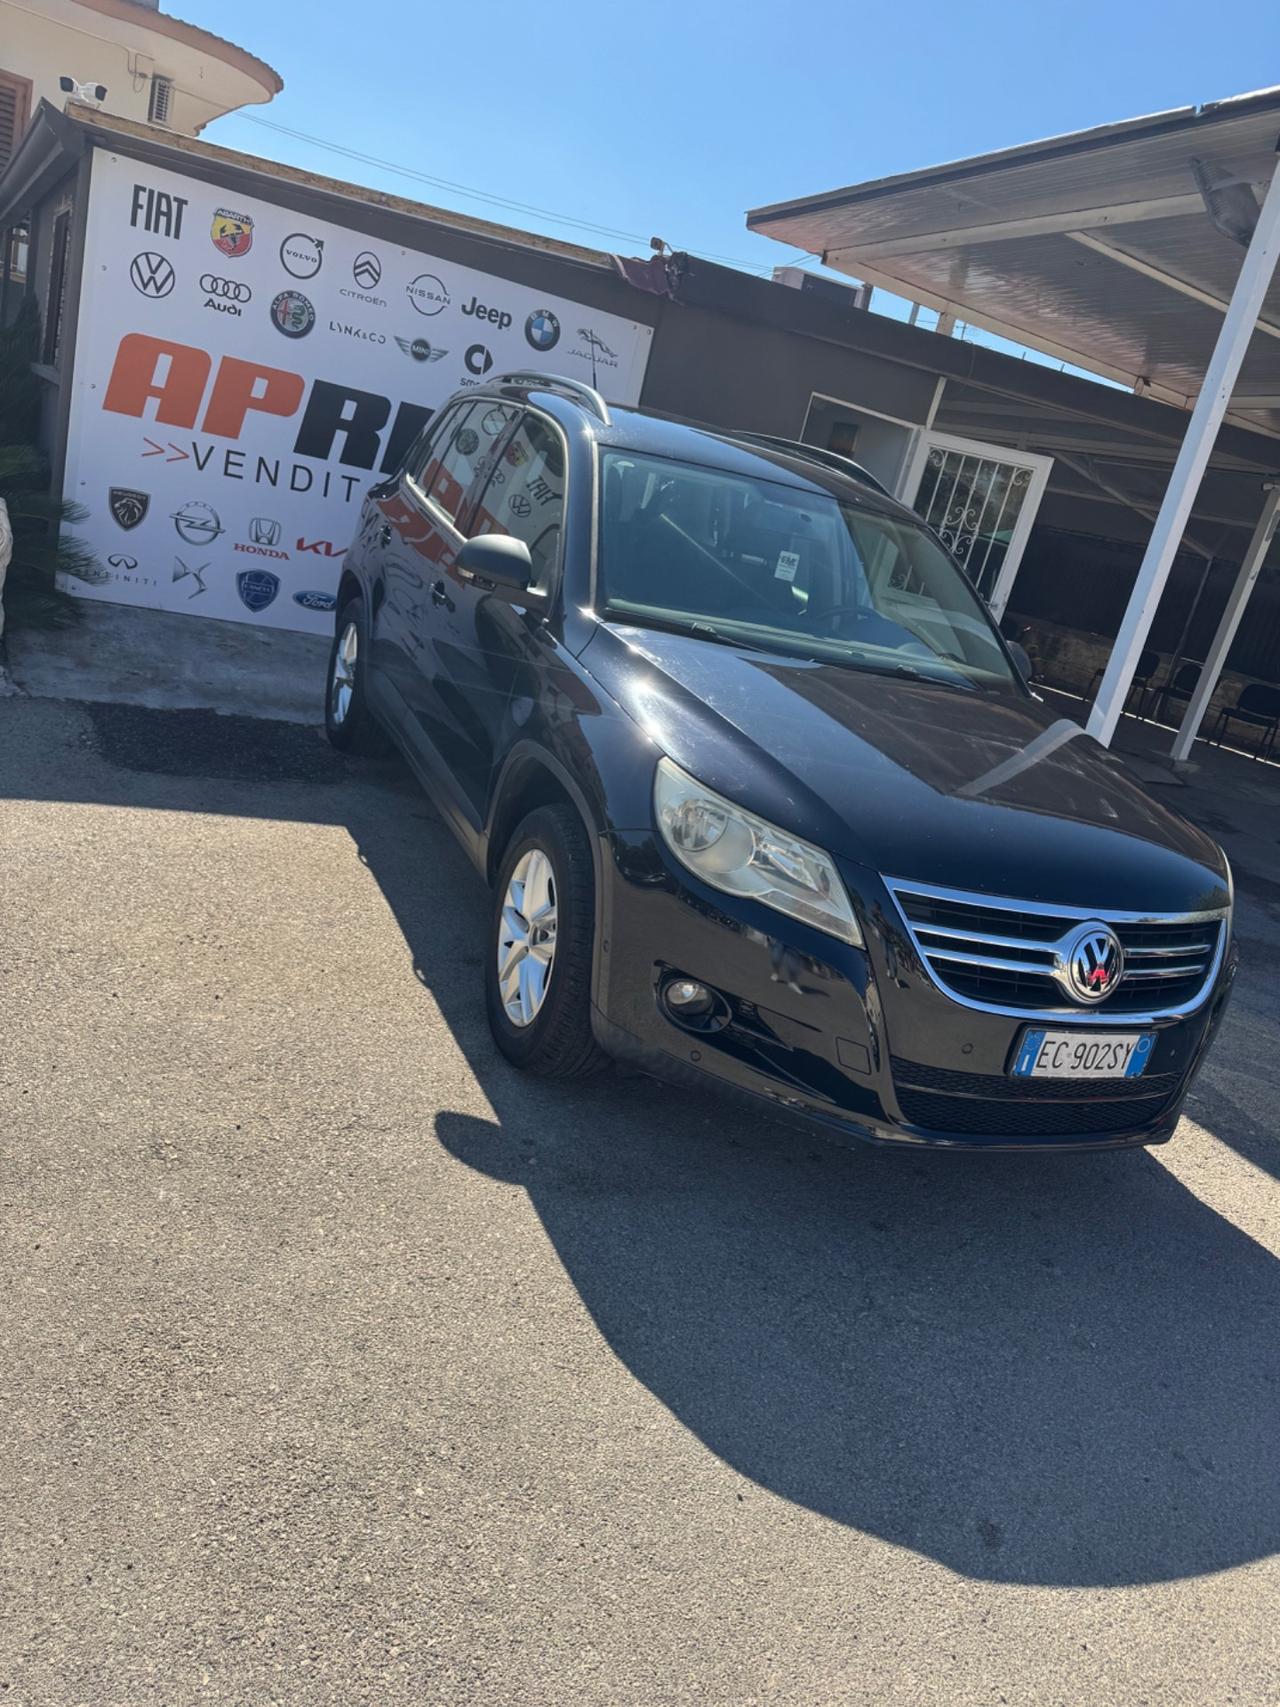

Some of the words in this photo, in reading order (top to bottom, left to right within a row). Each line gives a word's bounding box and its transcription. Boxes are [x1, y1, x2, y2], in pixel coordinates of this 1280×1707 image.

[130, 184, 188, 240] FIAT
[286, 249, 317, 264] VOLVO
[405, 285, 451, 306] NISSAN
[203, 298, 242, 317] Audi
[461, 296, 512, 330] Jeep
[234, 543, 290, 561] HONDA
[303, 592, 335, 609] Ford
[1036, 1040, 1069, 1070] EC
[1070, 1041, 1136, 1071] 902SY
